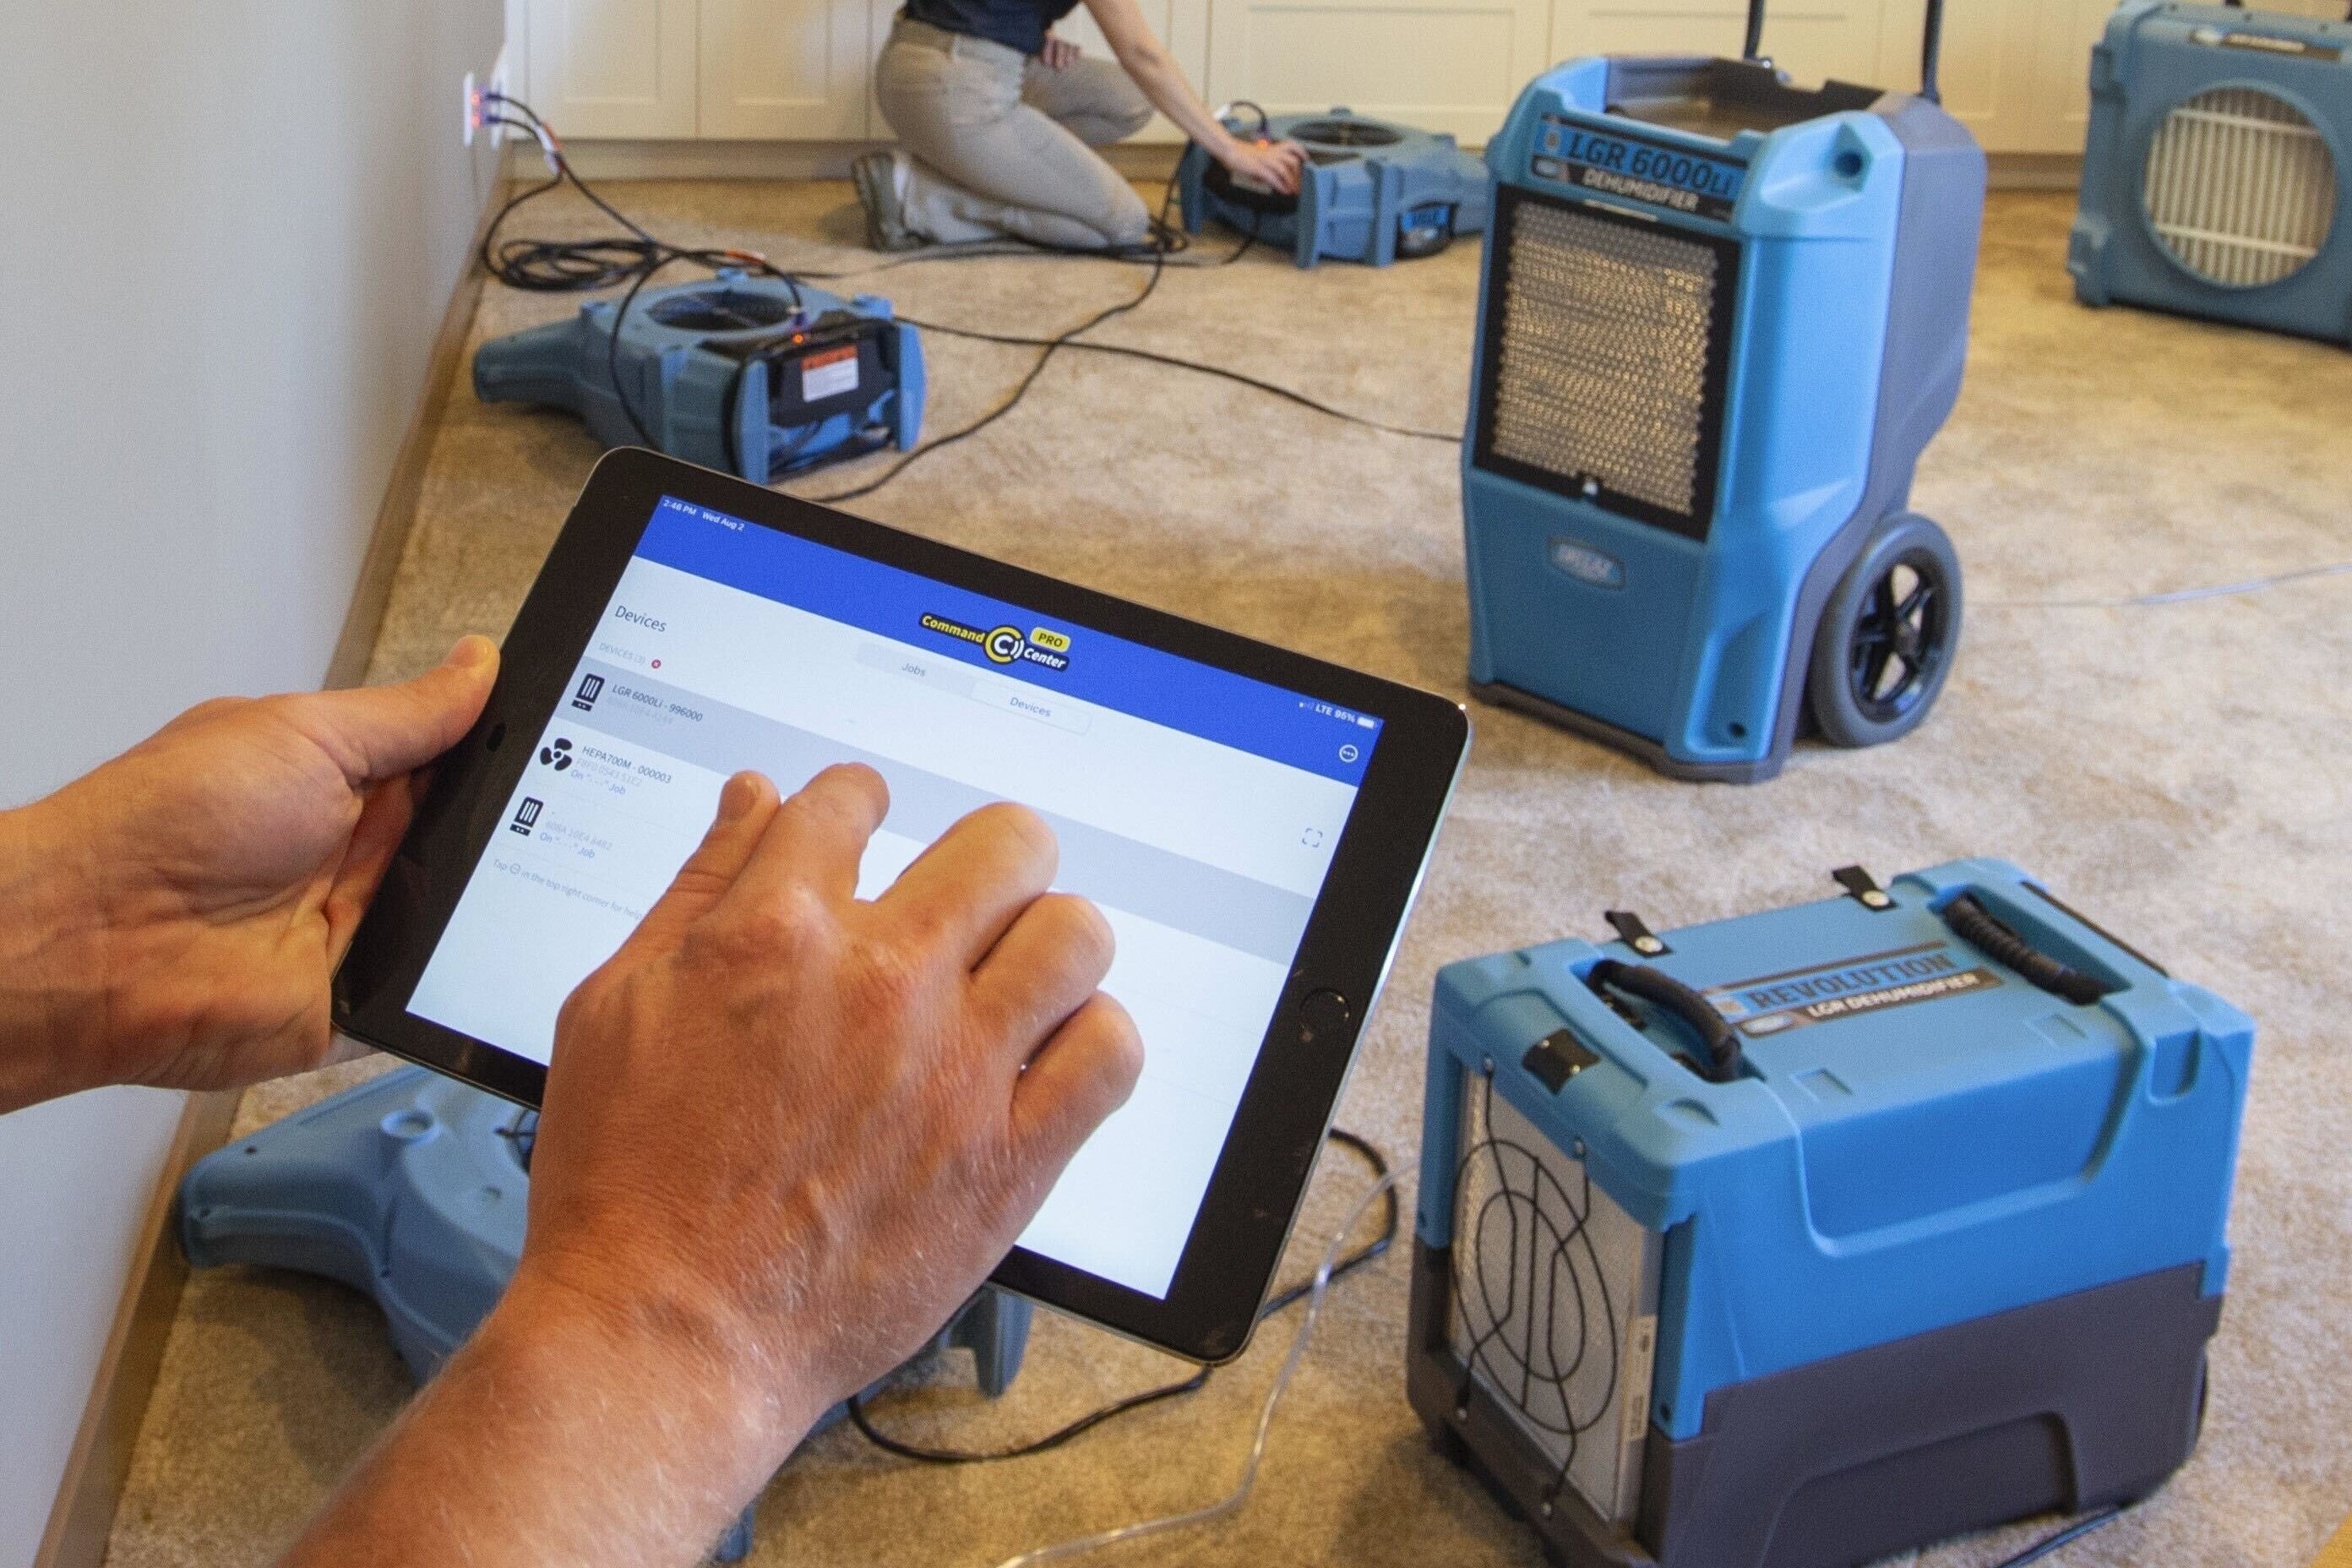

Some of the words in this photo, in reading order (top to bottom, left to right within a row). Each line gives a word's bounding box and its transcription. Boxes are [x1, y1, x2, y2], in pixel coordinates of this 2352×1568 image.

[1566, 132, 1627, 171] LGR
[1582, 167, 1700, 213] DEHUMIDIFIER
[682, 505, 697, 515] PM
[702, 511, 721, 524] Wed
[721, 518, 738, 531] Aug
[738, 523, 744, 531] 2
[614, 605, 667, 633] Devices
[598, 642, 633, 661] DEVICES
[922, 615, 986, 644] Command
[1023, 647, 1067, 670] Center
[1037, 633, 1063, 648] PRO
[901, 662, 927, 678] Jobs
[612, 683, 633, 698] LGR
[668, 703, 704, 722] 996000
[1010, 696, 1052, 718] Devices
[1315, 704, 1332, 716] LTE
[569, 769, 584, 780] On
[607, 783, 626, 795] Job
[638, 765, 672, 784] 000003
[539, 832, 553, 843] On
[577, 847, 596, 858] Job
[531, 872, 545, 884] the
[546, 879, 561, 894] top
[561, 885, 582, 899] right
[581, 893, 609, 907] corner
[610, 901, 623, 912] for
[1747, 953, 1958, 1010] REVOLUTION
[1806, 999, 1848, 1018] LGR
[1845, 972, 1980, 1010] DEHUMIDIFIER
